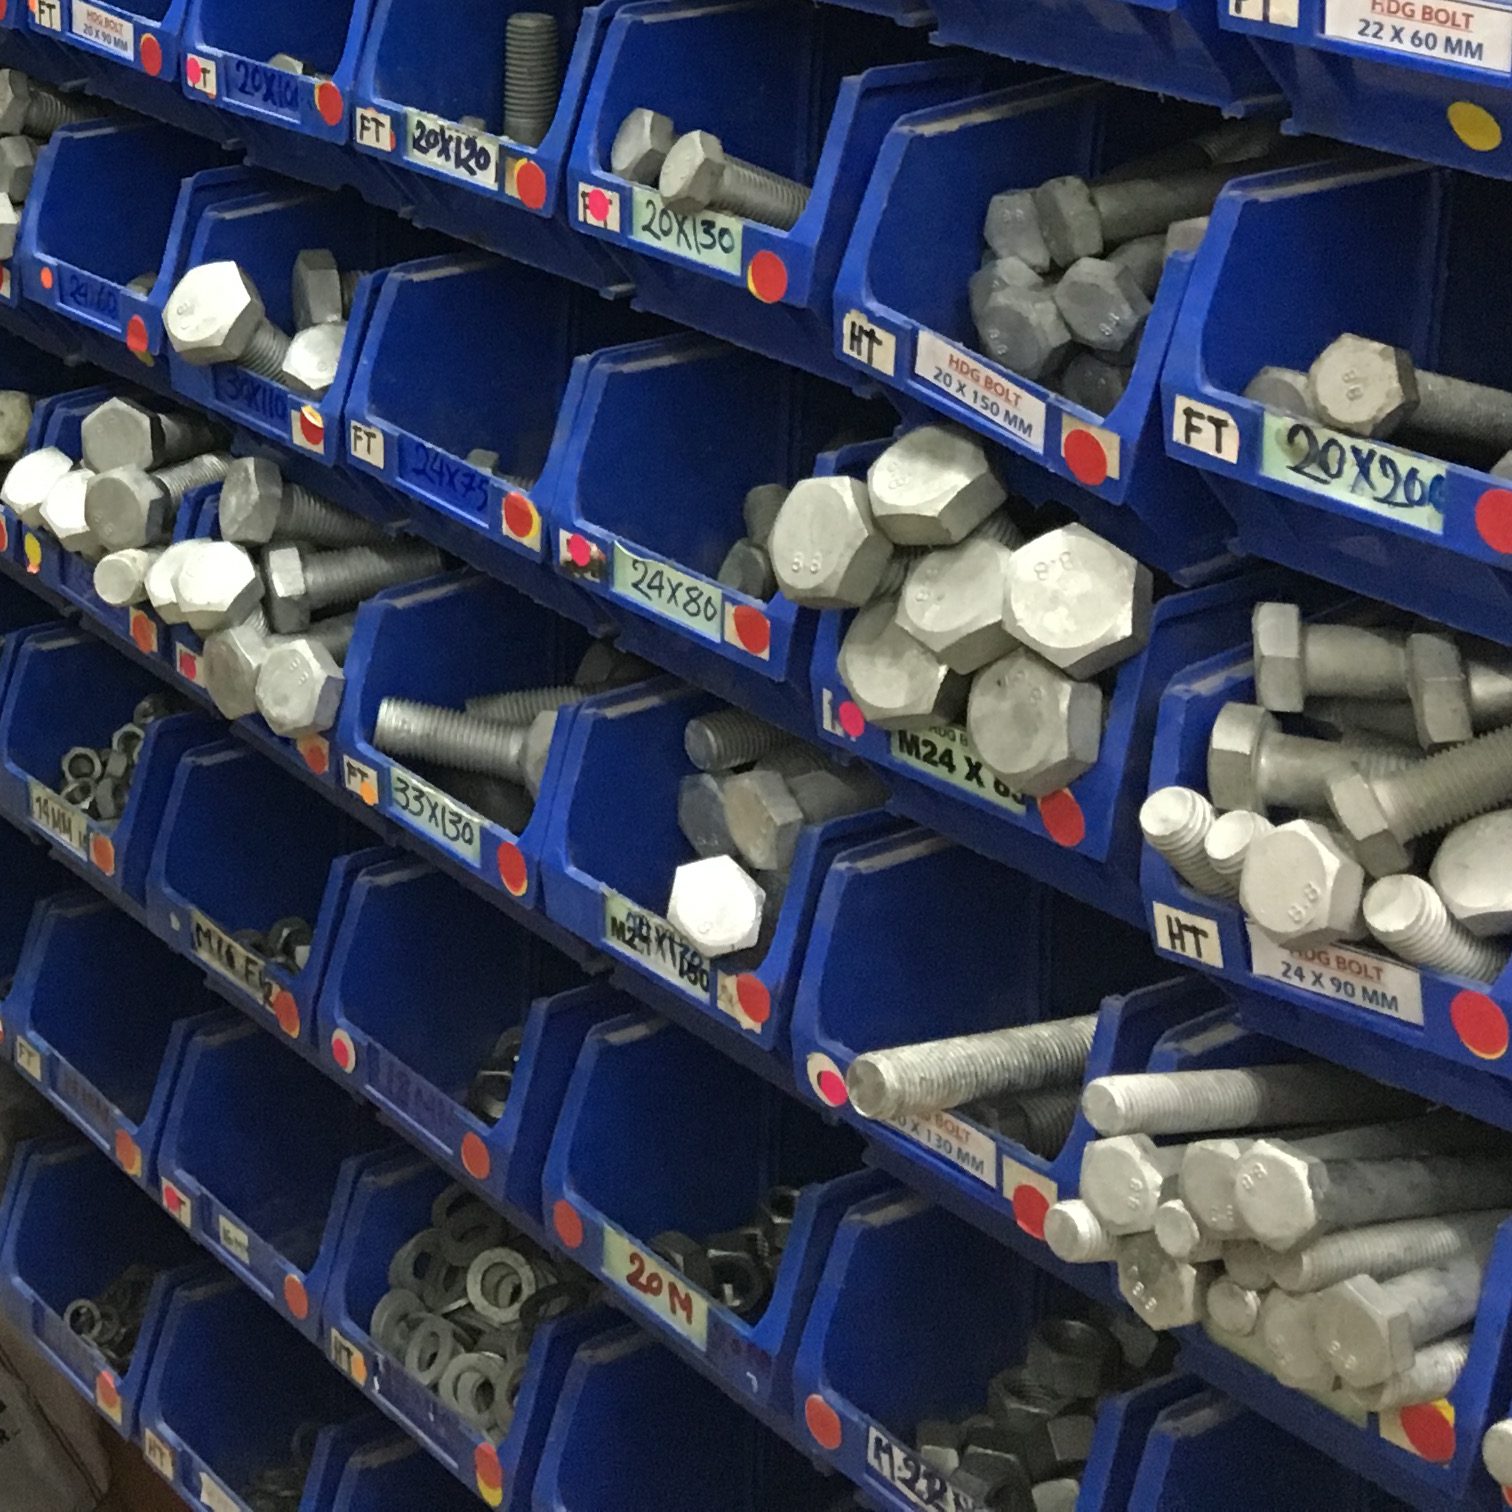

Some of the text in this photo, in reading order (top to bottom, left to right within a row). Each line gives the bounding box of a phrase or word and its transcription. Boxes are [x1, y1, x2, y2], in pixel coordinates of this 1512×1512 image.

[1358, 18, 1484, 62] 22 X 60 MM
[1421, 4, 1475, 31] BOLT
[359, 112, 385, 143] FT
[641, 199, 735, 255] 20X130
[850, 320, 883, 366] HT
[933, 365, 1033, 439] 20 X 150 MM
[948, 353, 1023, 409] HDG BOLT
[352, 425, 377, 456] FT
[1183, 406, 1230, 455] FT
[630, 558, 717, 622] 24X80
[897, 728, 956, 774] M24
[964, 754, 986, 788] X
[1166, 914, 1209, 958] HT
[1281, 959, 1399, 1013] 24 X 90 MM
[1336, 950, 1384, 982] BOLT
[911, 1121, 985, 1175] X 130 MM
